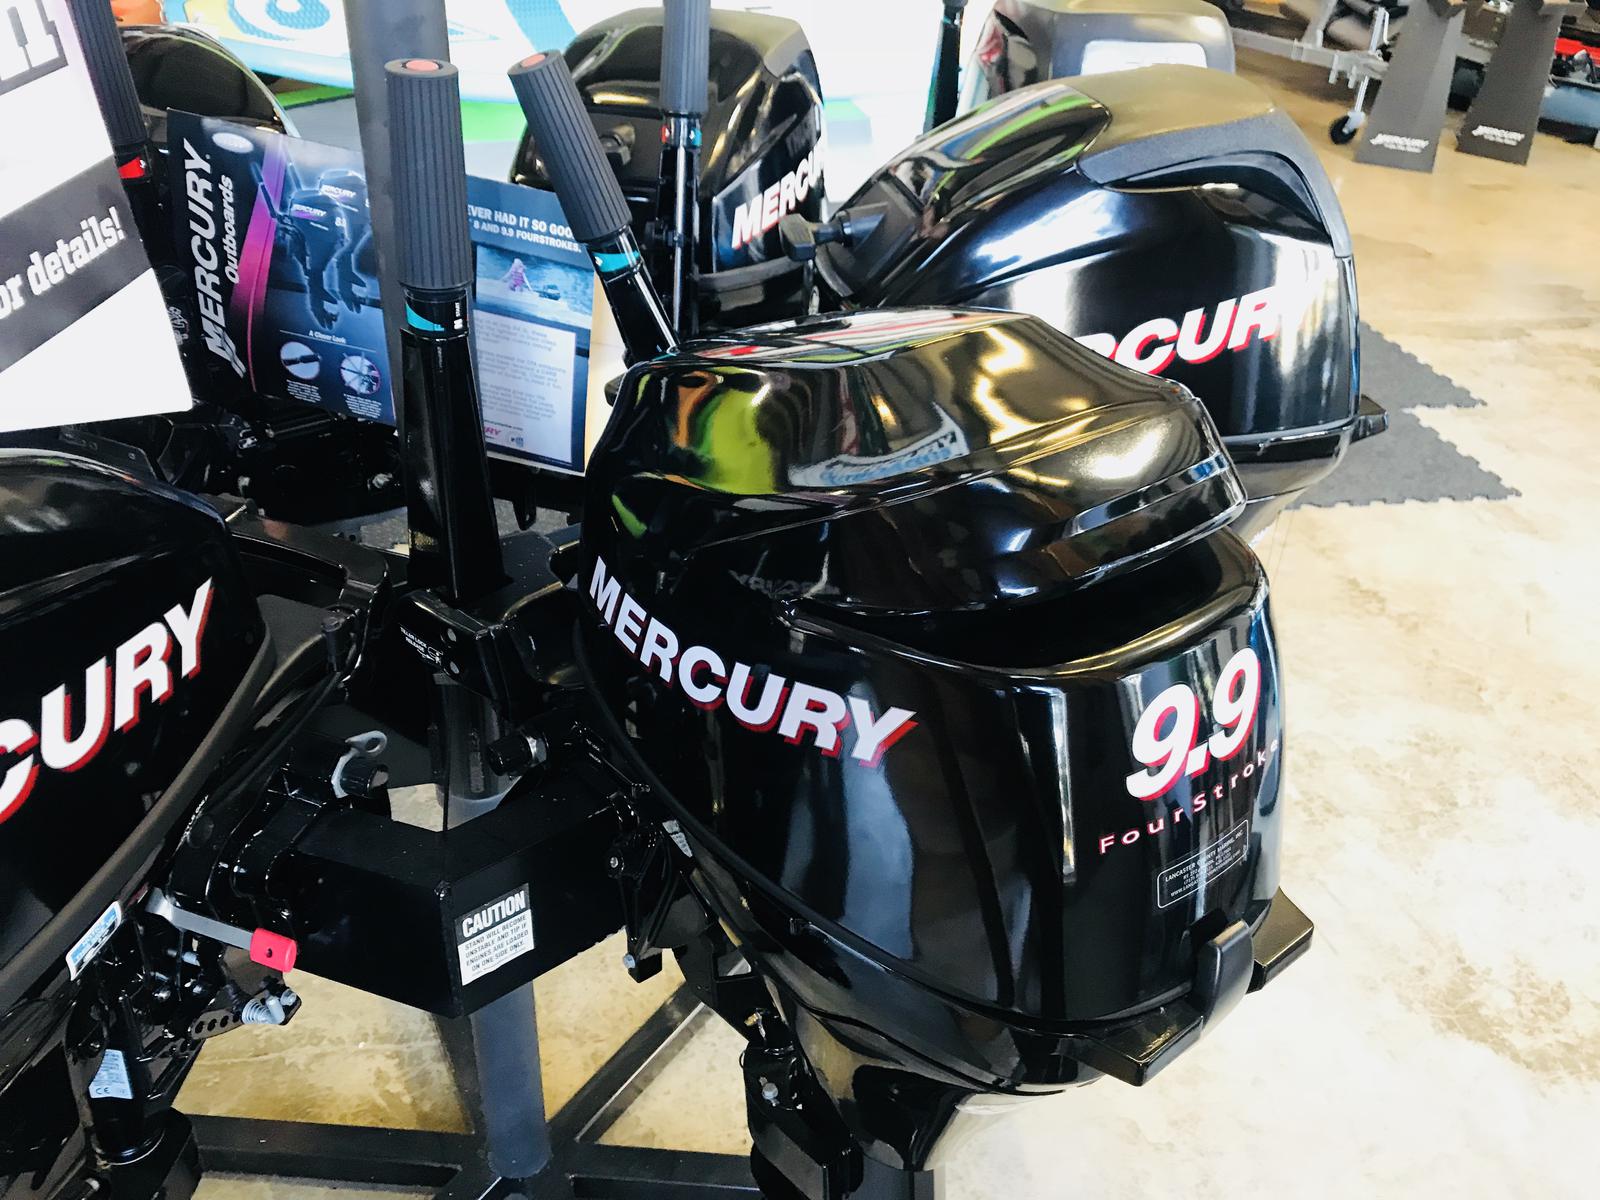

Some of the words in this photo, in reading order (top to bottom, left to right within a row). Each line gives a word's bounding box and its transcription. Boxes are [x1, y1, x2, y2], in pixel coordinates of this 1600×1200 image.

[219, 175, 240, 284] Outboards
[473, 220, 479, 229] 8
[481, 222, 499, 234] AND
[500, 226, 514, 237] 9.9
[516, 229, 582, 253] FOURSTROKES.
[495, 210, 516, 225] HAD
[519, 216, 529, 228] IT
[532, 219, 546, 233] SO
[549, 223, 574, 240] GOO
[27, 206, 126, 296] details!
[184, 138, 247, 378] MERCURY
[589, 556, 920, 768] MERCURY
[1126, 648, 1262, 801] 9.9
[1099, 739, 1278, 855] FourStroke
[462, 890, 526, 938] CAUTION
[465, 936, 484, 950] STAND
[486, 929, 500, 939] WILL
[501, 915, 526, 931] BECOME
[465, 940, 495, 958] UNSTABLE
[497, 932, 509, 942] AND
[510, 927, 520, 937] TIP
[466, 949, 492, 966] ENGINES
[494, 943, 504, 952] ARE
[506, 930, 528, 946] LOADED
[481, 957, 493, 967] ONE
[495, 949, 508, 959] SIDE
